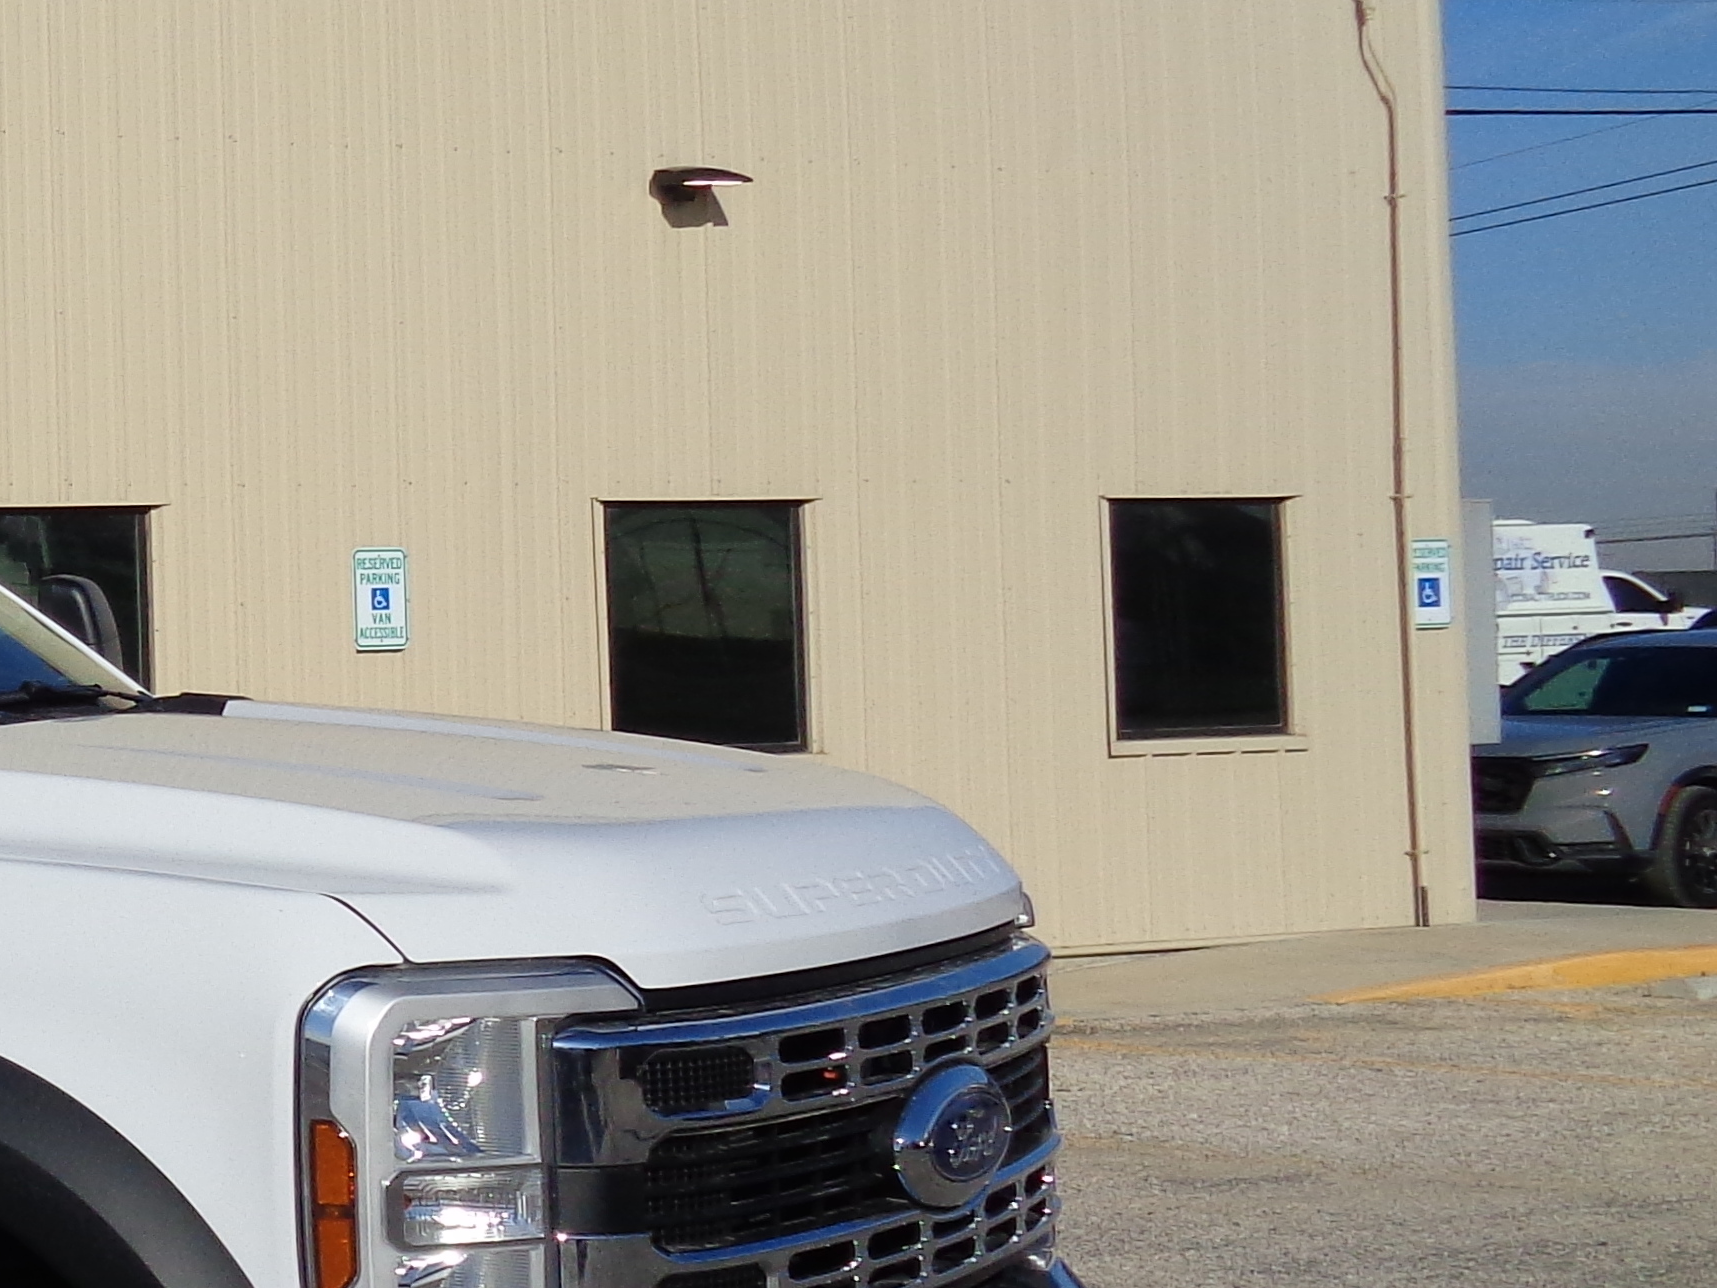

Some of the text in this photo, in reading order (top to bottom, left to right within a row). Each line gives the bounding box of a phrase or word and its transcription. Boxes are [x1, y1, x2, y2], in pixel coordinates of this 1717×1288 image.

[357, 557, 402, 570] RESERVED
[1530, 551, 1590, 570] Service
[359, 573, 401, 585] PARKING
[371, 612, 392, 625] VAN
[359, 626, 404, 639] ACCESSIBLE
